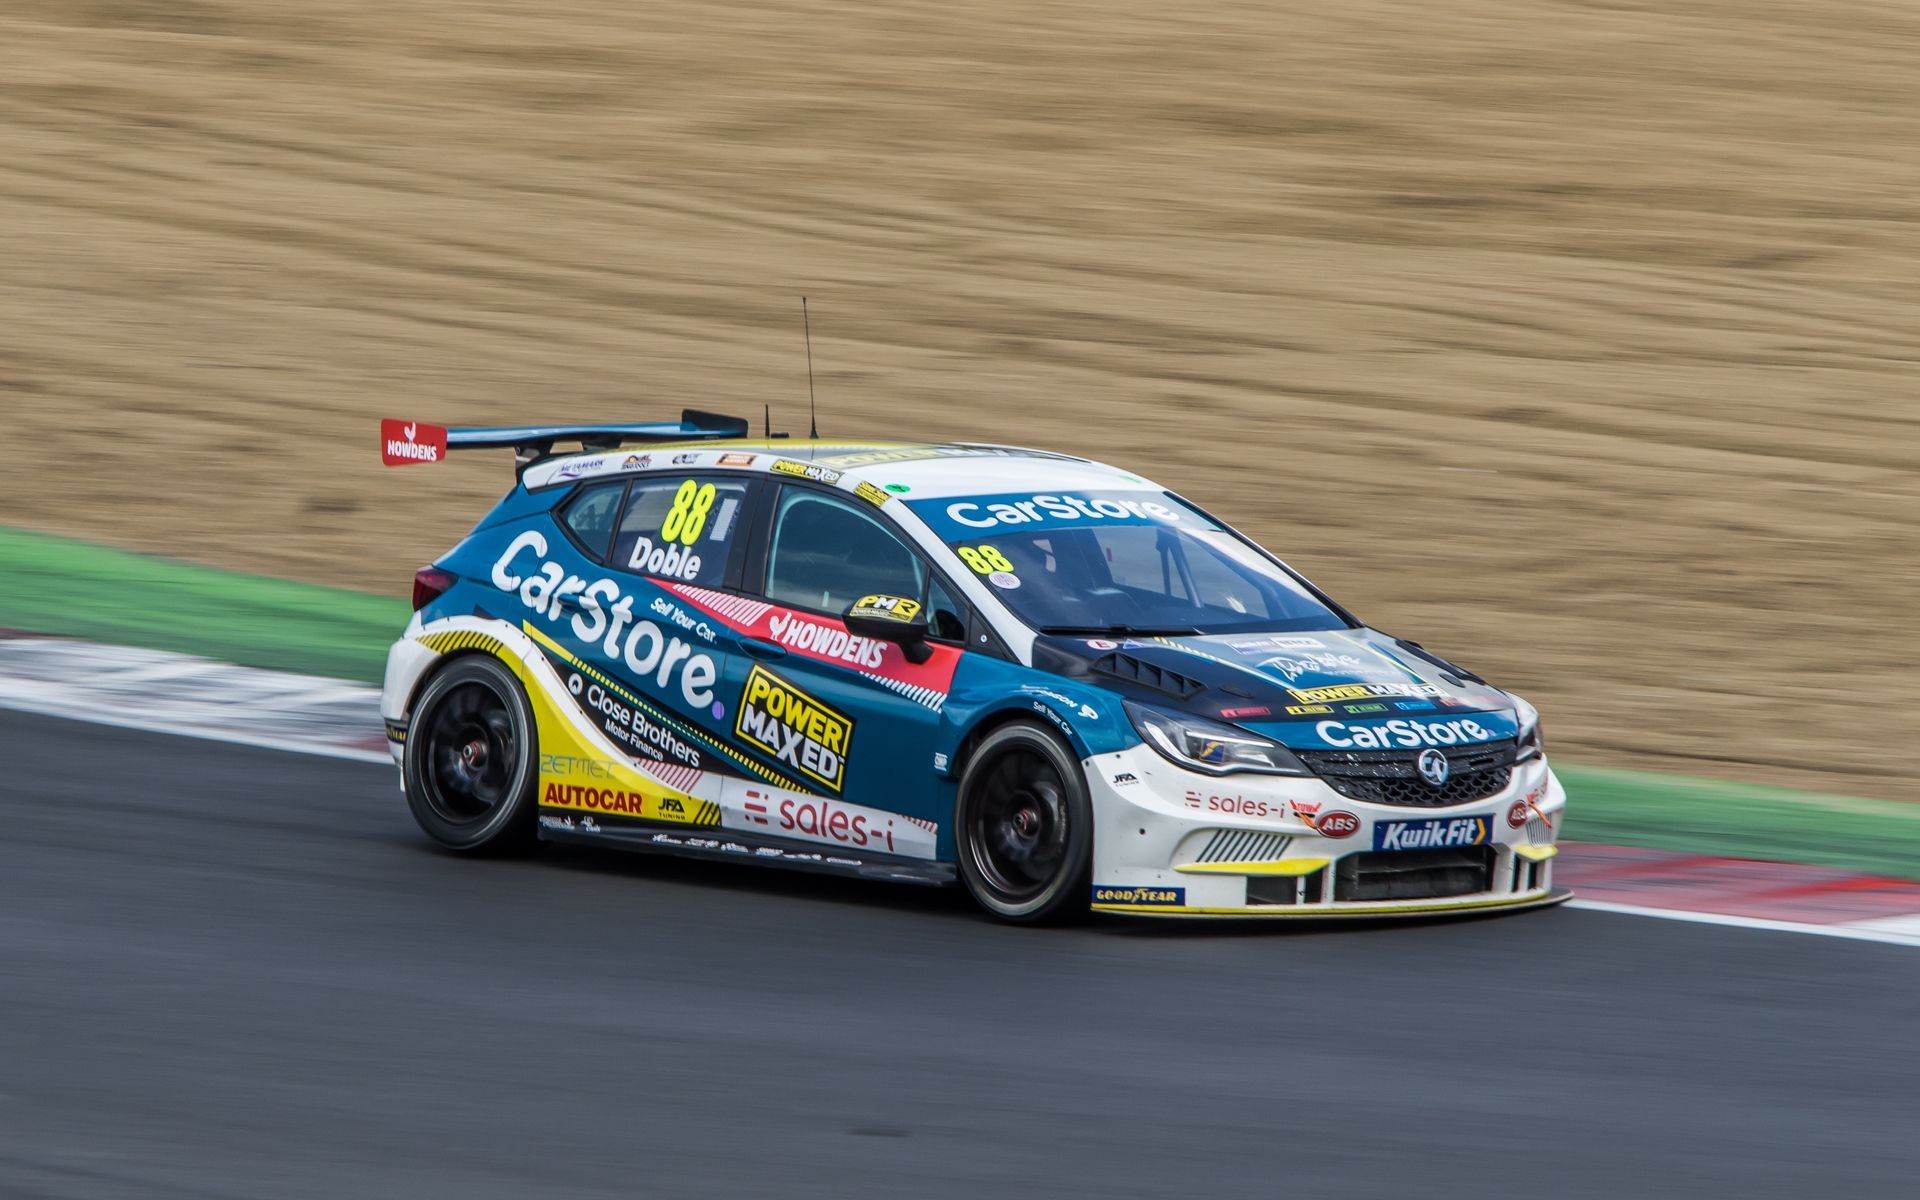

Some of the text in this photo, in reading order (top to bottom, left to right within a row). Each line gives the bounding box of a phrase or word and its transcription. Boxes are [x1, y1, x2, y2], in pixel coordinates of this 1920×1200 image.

[387, 440, 437, 461] HOWDENS
[774, 460, 807, 476] POWER
[805, 466, 840, 483] MAXED
[661, 480, 716, 546] 88
[946, 495, 1180, 528] CarStore
[628, 536, 701, 580] Doble
[957, 544, 1015, 575] 88
[650, 597, 675, 617] Sell
[671, 607, 697, 631] Your
[857, 596, 917, 614] PMR
[782, 619, 888, 669] HOWDENS
[1294, 684, 1372, 702] POWER
[586, 684, 701, 768] Close Brothers
[749, 674, 844, 753] POWER
[604, 718, 664, 762] Motor Finance
[741, 702, 844, 780] MAXED
[1112, 772, 1138, 784] JFA
[544, 783, 643, 815] AUTOCAR
[658, 797, 686, 814] JFA
[1208, 794, 1285, 819] sales-i
[658, 811, 686, 821] TUNING
[779, 799, 894, 853] sales-i
[1322, 817, 1357, 832] ABS
